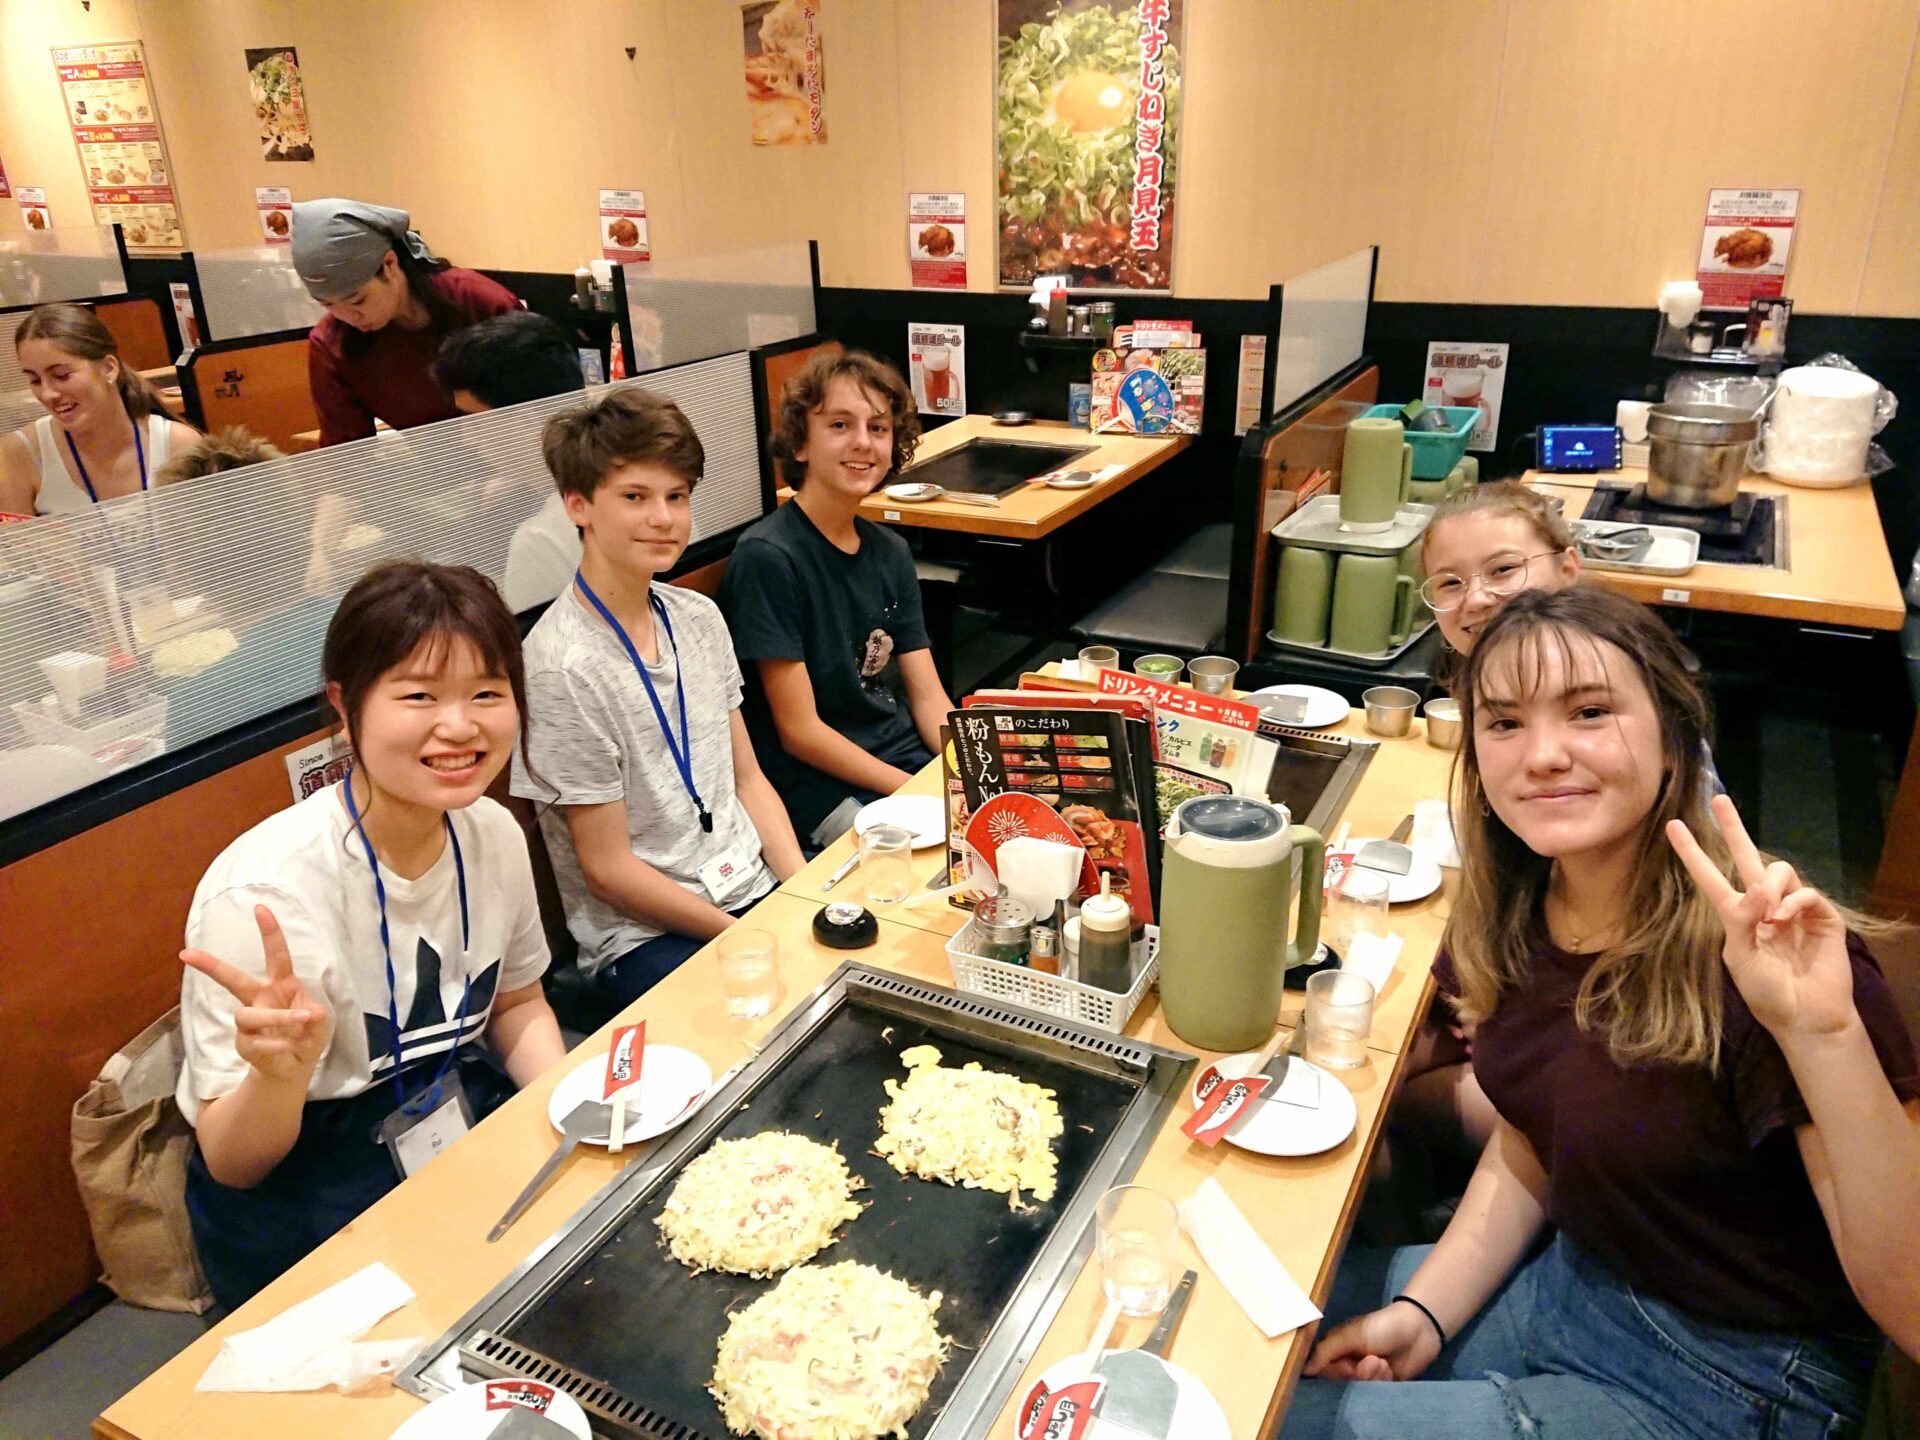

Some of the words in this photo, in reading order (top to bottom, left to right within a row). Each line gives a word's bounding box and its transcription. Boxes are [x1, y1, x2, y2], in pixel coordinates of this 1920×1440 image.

[1131, 0, 1169, 249] 牛すじねぎ月見玉
[1102, 673, 1215, 713] ドリンクメニュー
[298, 754, 324, 769] Since
[964, 717, 999, 784] 粉もん
